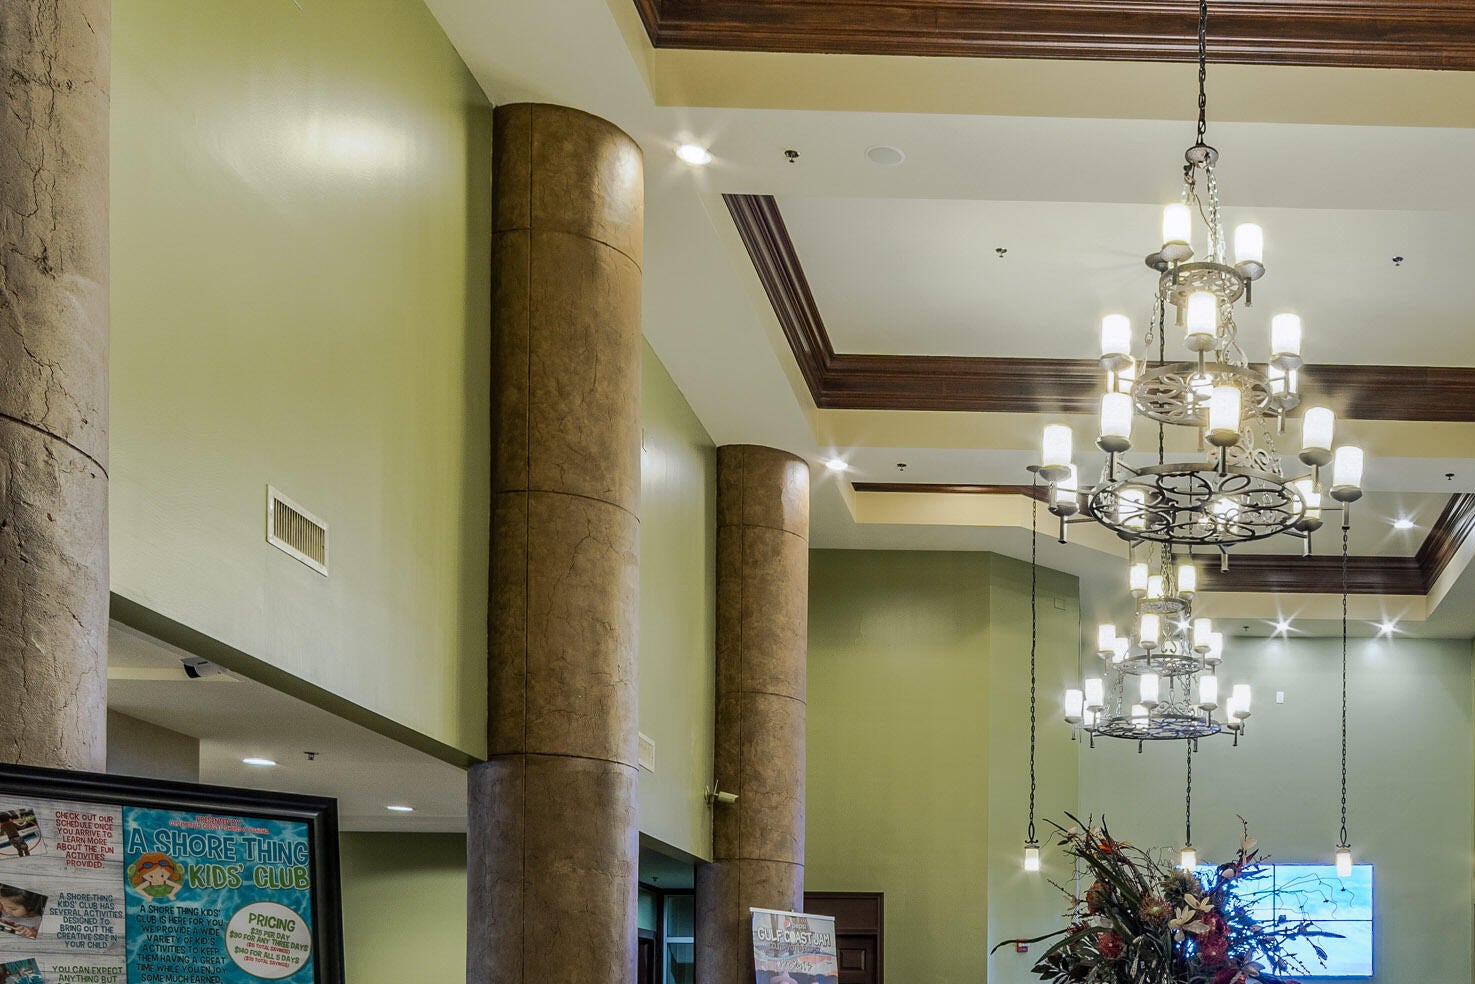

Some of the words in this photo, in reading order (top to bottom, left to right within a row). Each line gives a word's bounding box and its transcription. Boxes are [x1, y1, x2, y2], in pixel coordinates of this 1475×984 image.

[55, 811, 79, 820] CHECK
[81, 813, 96, 821] OUT
[55, 818, 92, 828] SCHEDULE
[94, 822, 112, 830] ONCE
[75, 828, 100, 837] ARRIVE
[63, 835, 85, 843] LEARN
[87, 837, 106, 845] MORE
[56, 842, 81, 851] ABOUT
[84, 844, 96, 852] THE
[127, 827, 148, 855] A
[153, 829, 236, 860] SHORE
[241, 837, 309, 866] THING
[66, 851, 104, 860] ACTIVITIES
[252, 865, 310, 889] CLUB
[66, 892, 90, 900] SHORE
[79, 901, 97, 909] CLUB
[49, 907, 80, 916] SEVERAL
[84, 909, 122, 918] ACTIVITIES
[148, 905, 174, 914] SHORE
[176, 907, 198, 915] THING
[200, 908, 220, 917] KIDS'
[63, 916, 97, 924] DESIGNED
[136, 915, 156, 923] CLUB
[248, 912, 295, 931] PRICING
[156, 925, 190, 934] PROVIDE
[57, 931, 91, 940] CREATIVE
[146, 934, 179, 943] VARIETY
[194, 937, 215, 945] KID'S
[229, 930, 241, 938] $90
[243, 933, 255, 941] FOR
[271, 938, 289, 948] THREE
[290, 942, 308, 951] DAYS
[757, 927, 783, 942] GULF
[784, 931, 813, 946] COAST
[814, 933, 831, 948] JAM
[143, 944, 185, 953] ACTIVITIES
[200, 947, 219, 955] KEEP
[136, 953, 158, 962] THEM
[160, 954, 189, 963] HAVING
[200, 956, 225, 964] GREAT
[72, 965, 89, 973] CAN
[91, 966, 122, 974] EXPECT
[157, 964, 180, 972] WHILE
[201, 966, 226, 974] ENJOY
[58, 974, 98, 982] ANYTHING
[101, 975, 117, 983] BUT
[141, 973, 163, 982] SOME
[165, 974, 188, 982] MUCH
